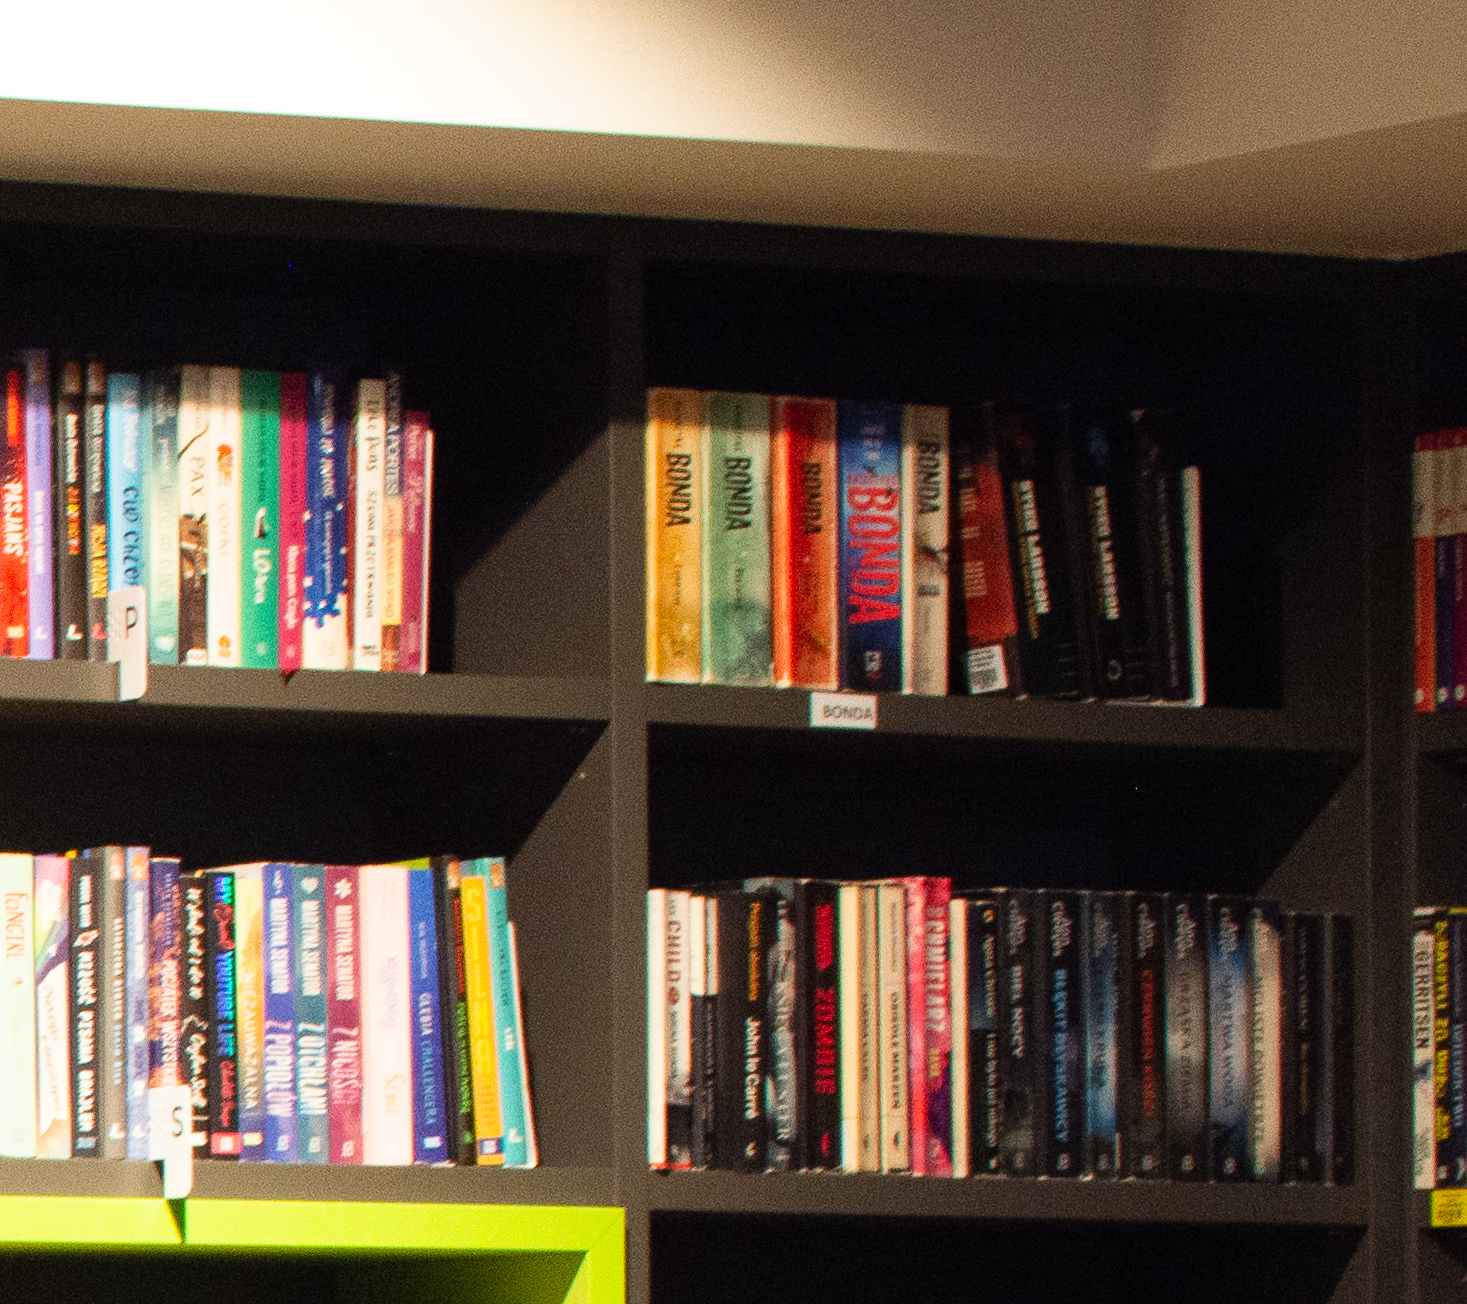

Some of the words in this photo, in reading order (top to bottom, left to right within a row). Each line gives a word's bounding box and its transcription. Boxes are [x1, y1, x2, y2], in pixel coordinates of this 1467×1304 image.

[667, 453, 691, 527] BONDA
[724, 456, 753, 531] BONDA
[803, 462, 822, 534] BONDA
[919, 440, 941, 515] BONDA
[4, 482, 23, 556] PASJANS
[848, 487, 900, 624] BONDA
[823, 705, 873, 722] BONDA
[1415, 951, 1428, 1049] GERRITSEN
[815, 987, 835, 1094] ZOMBIE
